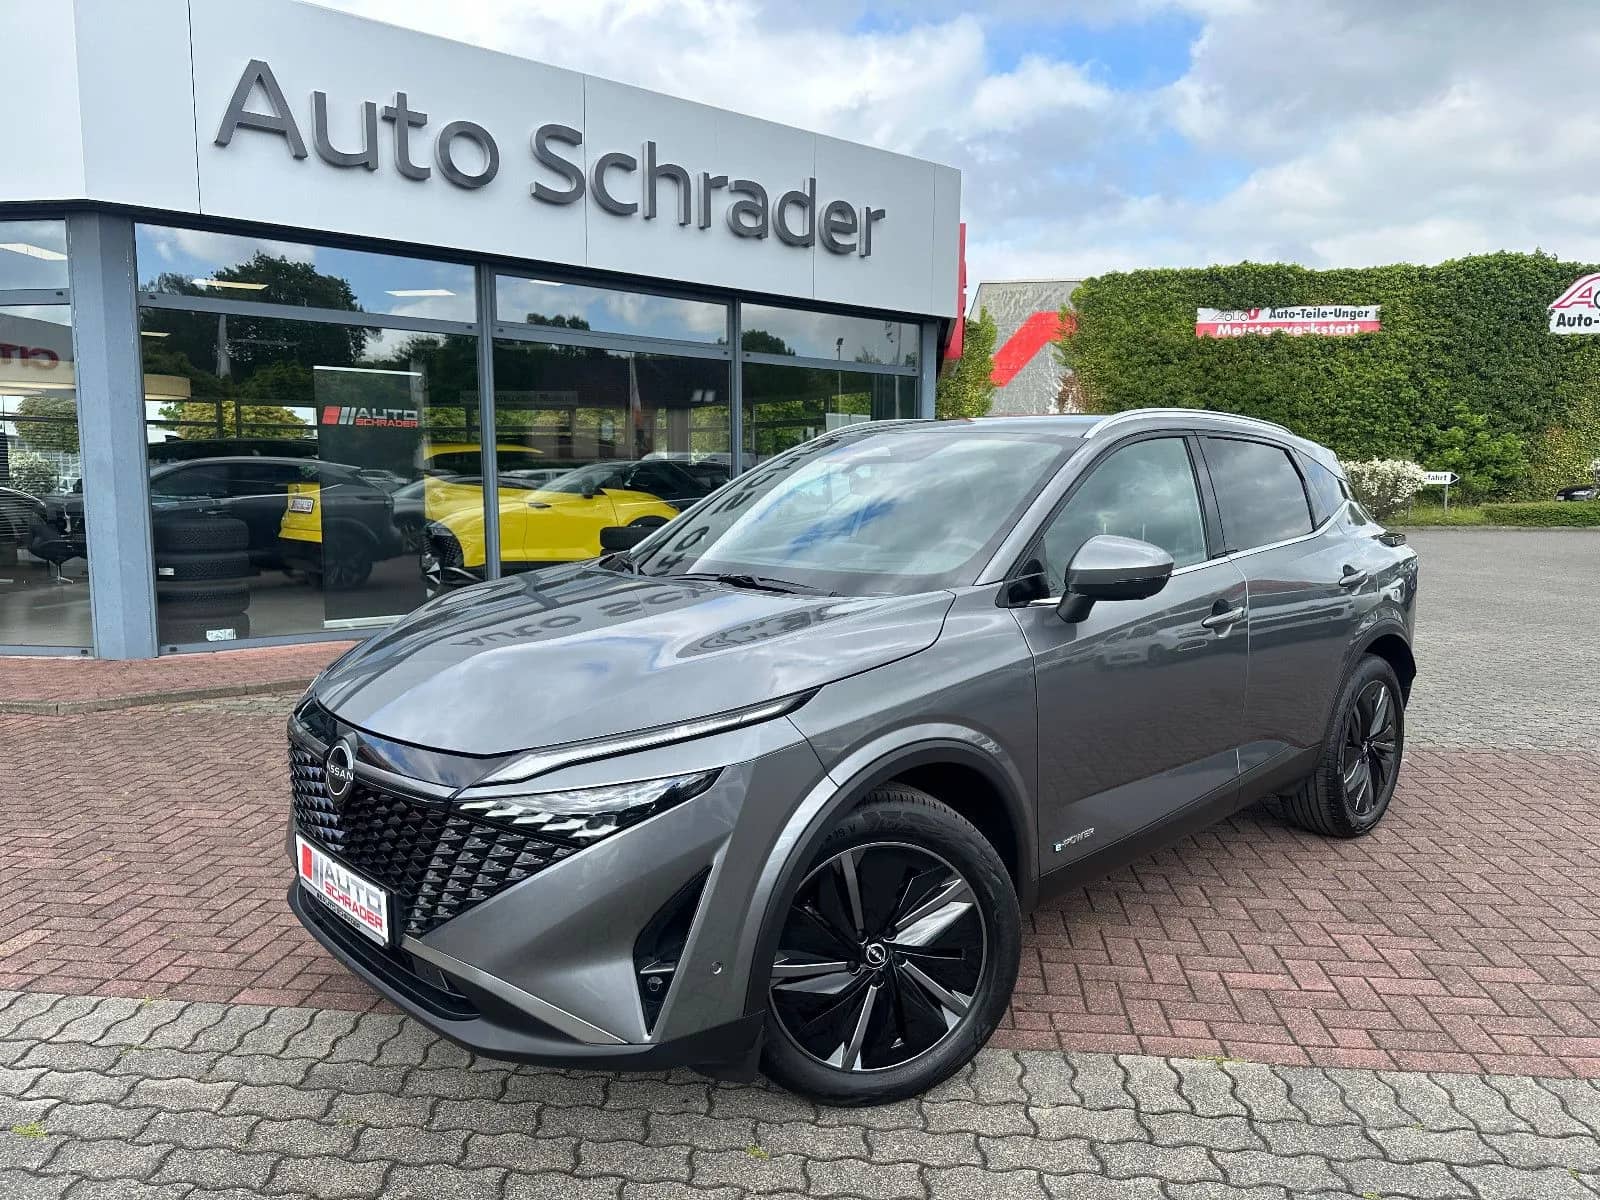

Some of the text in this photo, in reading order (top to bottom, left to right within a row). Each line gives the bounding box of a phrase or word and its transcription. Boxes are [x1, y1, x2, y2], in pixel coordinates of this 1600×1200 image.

[214, 58, 886, 258] Auto Schrader
[1269, 307, 1370, 321] Auto-Teile-Unger
[1555, 312, 1600, 328] Auto-
[356, 407, 418, 420] AUTO
[355, 418, 418, 428] SCHRADER
[324, 861, 383, 917] AUTO
[324, 881, 383, 931] SCHRADER
